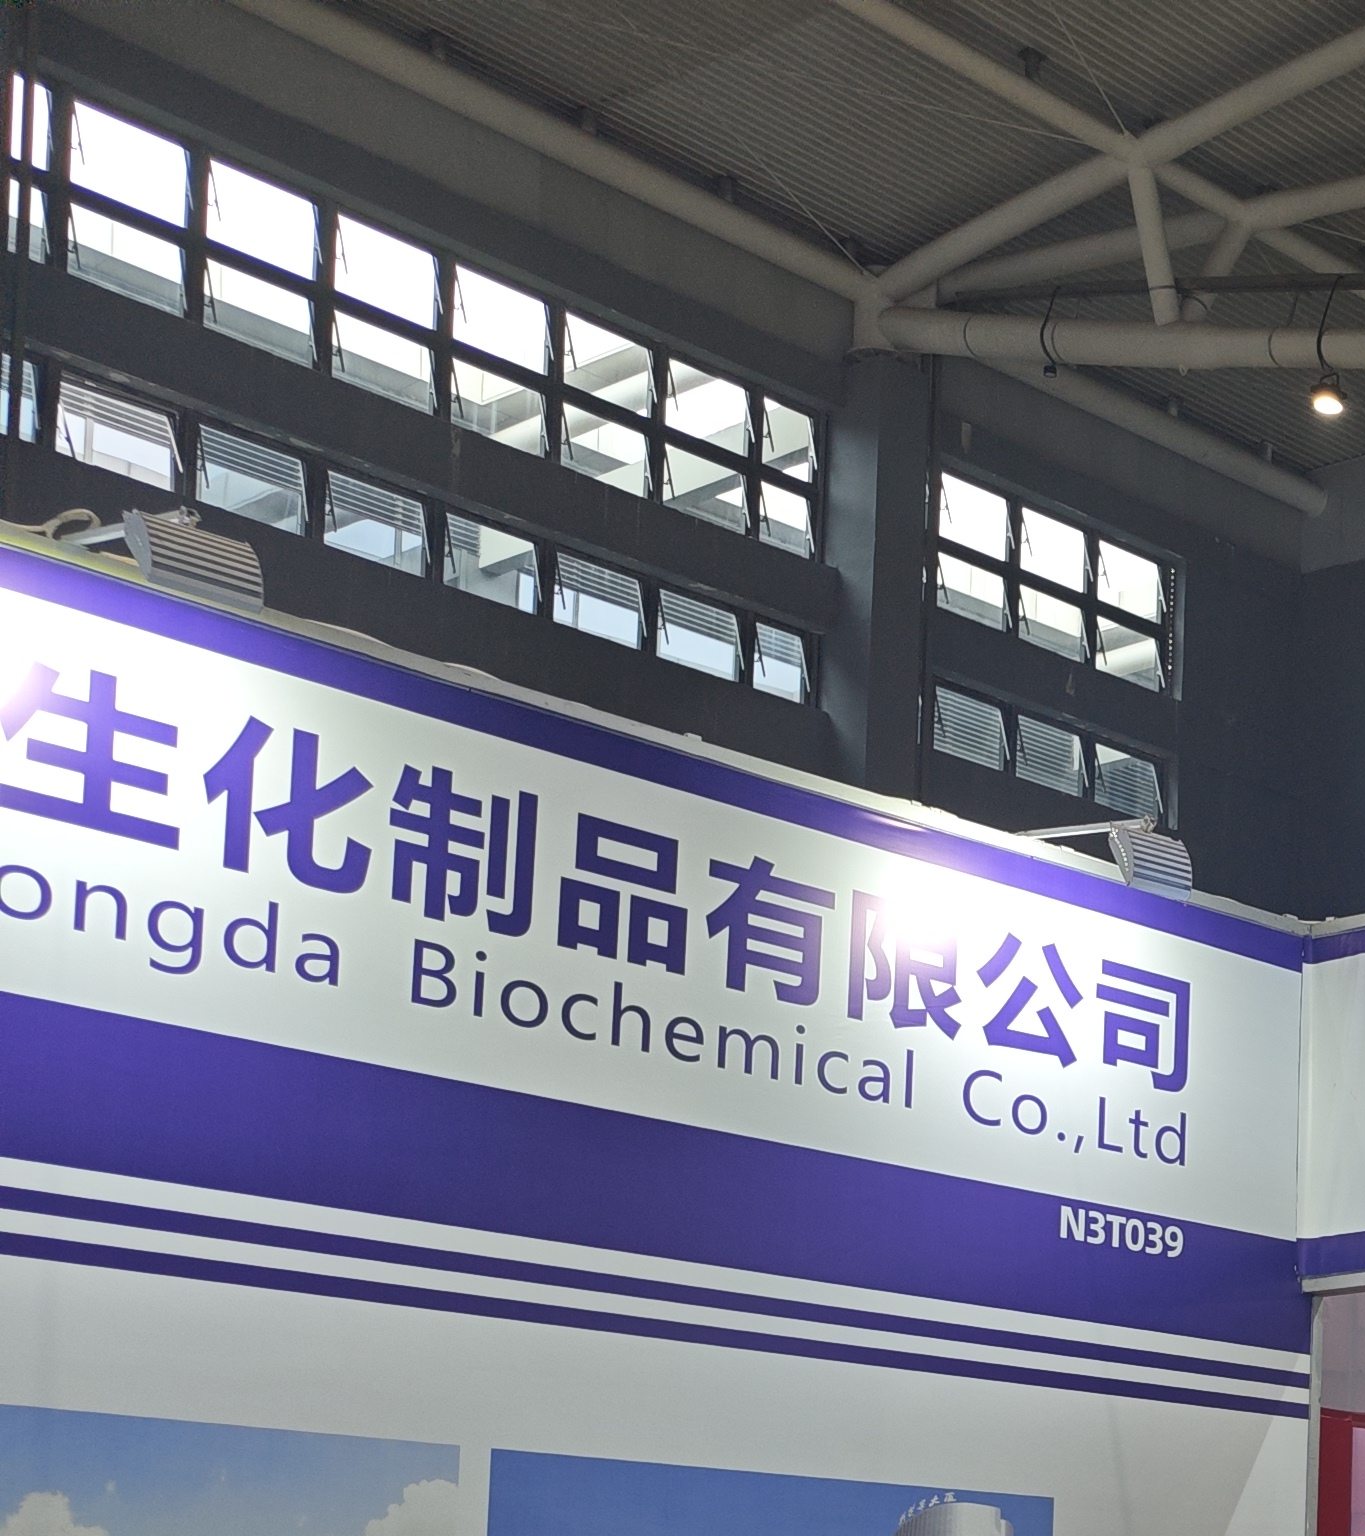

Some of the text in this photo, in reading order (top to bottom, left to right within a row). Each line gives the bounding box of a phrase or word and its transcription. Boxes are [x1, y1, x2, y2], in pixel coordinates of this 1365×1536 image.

[0, 660, 1192, 1093] 生化制品有限公司
[410, 938, 914, 1110] Biochemical
[962, 1050, 1188, 1168] Co.,Ltd
[1059, 1205, 1186, 1258] N3T039
